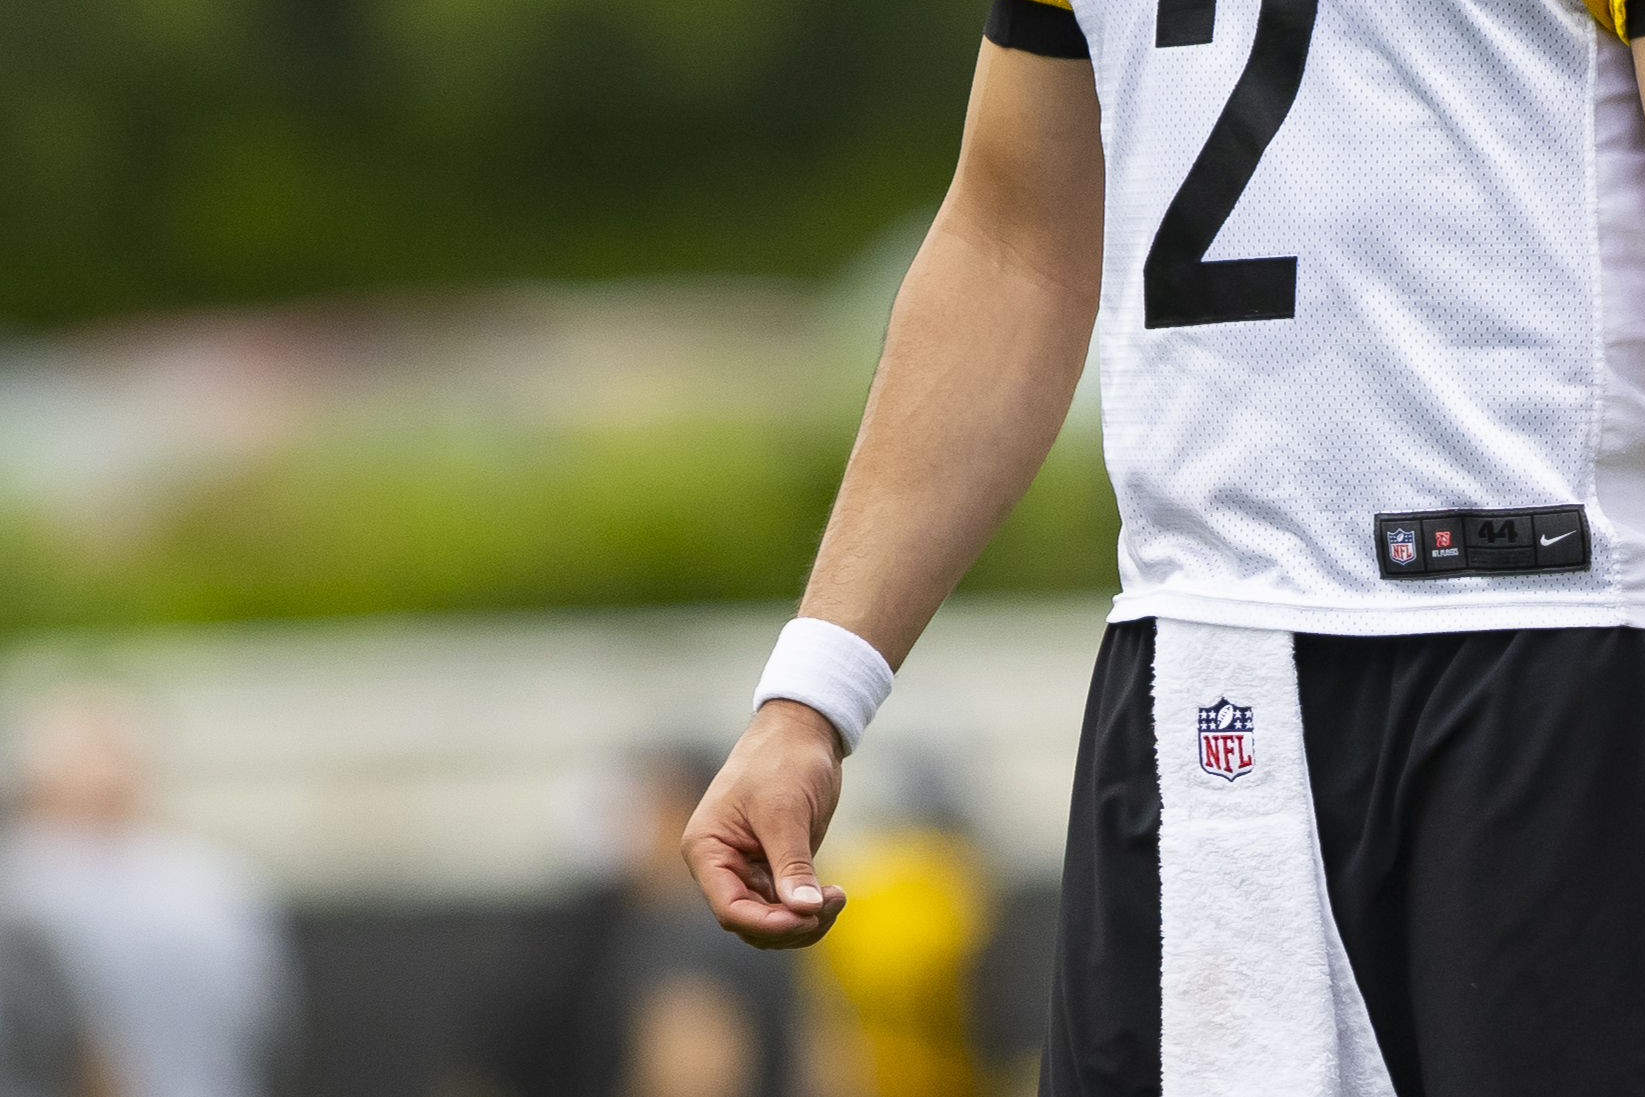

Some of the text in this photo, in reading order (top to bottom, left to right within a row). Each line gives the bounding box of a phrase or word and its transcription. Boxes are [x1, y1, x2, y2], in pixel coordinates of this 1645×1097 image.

[1478, 520, 1519, 544] 44
[1391, 544, 1413, 559] NFL
[1203, 735, 1252, 773] NFL
